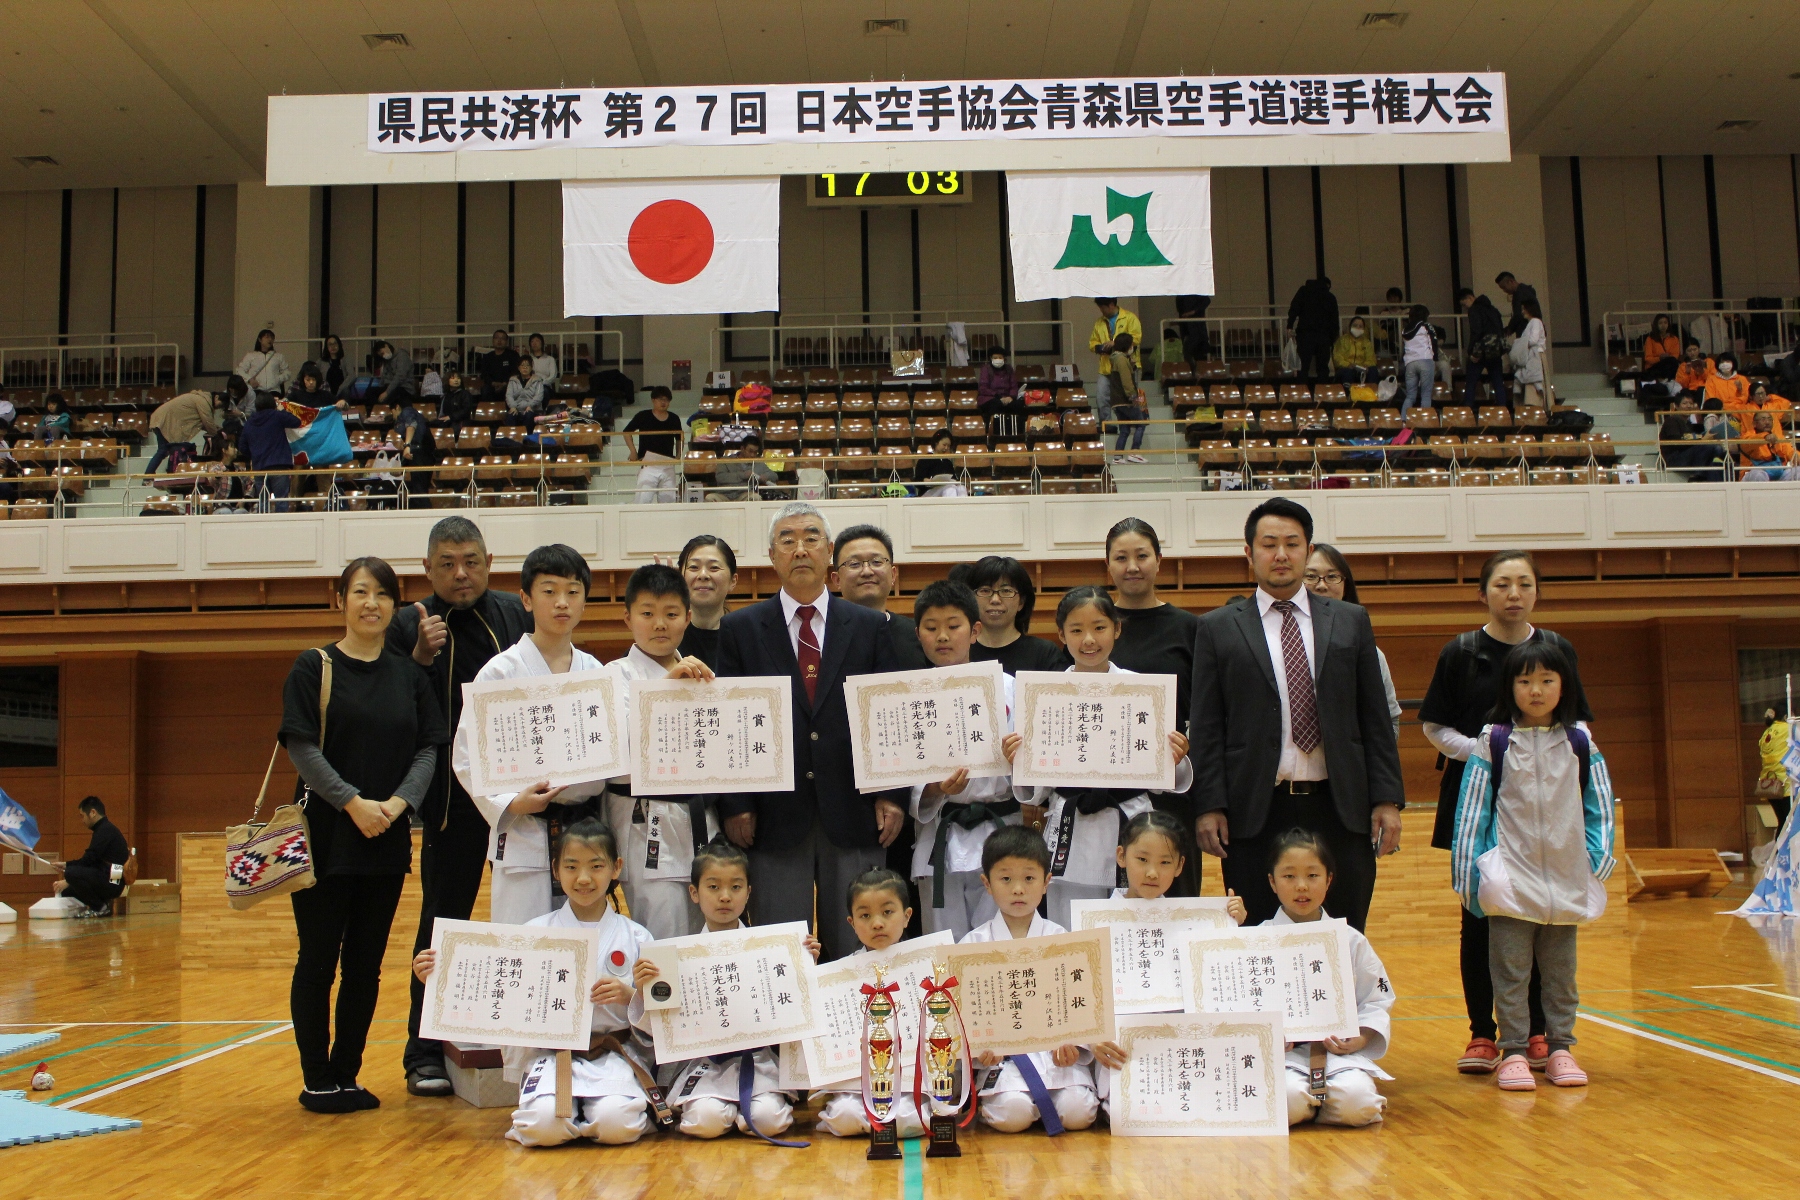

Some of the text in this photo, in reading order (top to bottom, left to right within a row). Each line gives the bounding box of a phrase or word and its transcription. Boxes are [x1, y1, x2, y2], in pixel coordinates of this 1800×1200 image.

[376, 94, 582, 144] 県民共済杯
[796, 76, 1493, 134] 日本空手協会青森県空手道選手権大会
[541, 703, 556, 732] 勝利の
[586, 704, 603, 744] 賞状
[706, 707, 720, 736] 勝利の
[752, 714, 767, 754] 賞状
[909, 700, 925, 760] 栄光を讃える
[923, 699, 937, 728] 勝利の
[968, 703, 985, 742] 賞状
[1076, 702, 1090, 763] 栄光を讃える
[1090, 703, 1104, 732] 勝利の
[1134, 711, 1149, 751] 賞状
[527, 705, 544, 765] 栄光を讃える
[692, 707, 707, 768] 栄光を讃える
[1136, 928, 1152, 989] 栄光を讃える
[1150, 928, 1165, 957] 勝利の
[490, 956, 509, 1020] 栄光を讃える
[509, 958, 524, 988] 勝利の
[551, 968, 570, 1011] 賞状
[725, 962, 740, 993] 勝利の
[773, 963, 793, 1005] 賞状
[1022, 967, 1037, 997] 勝利の
[1070, 968, 1087, 1009] 賞状
[1246, 956, 1263, 1012] 栄光を讃え
[1260, 956, 1276, 985] 勝利の
[1309, 959, 1328, 1002] 賞状
[710, 964, 730, 1028] 栄光を讃える
[1006, 969, 1023, 1030] 栄光を讃える
[1176, 1047, 1192, 1112] 栄光を讃える
[1191, 1047, 1206, 1079] 勝利の
[1241, 1054, 1258, 1098] 賞状
